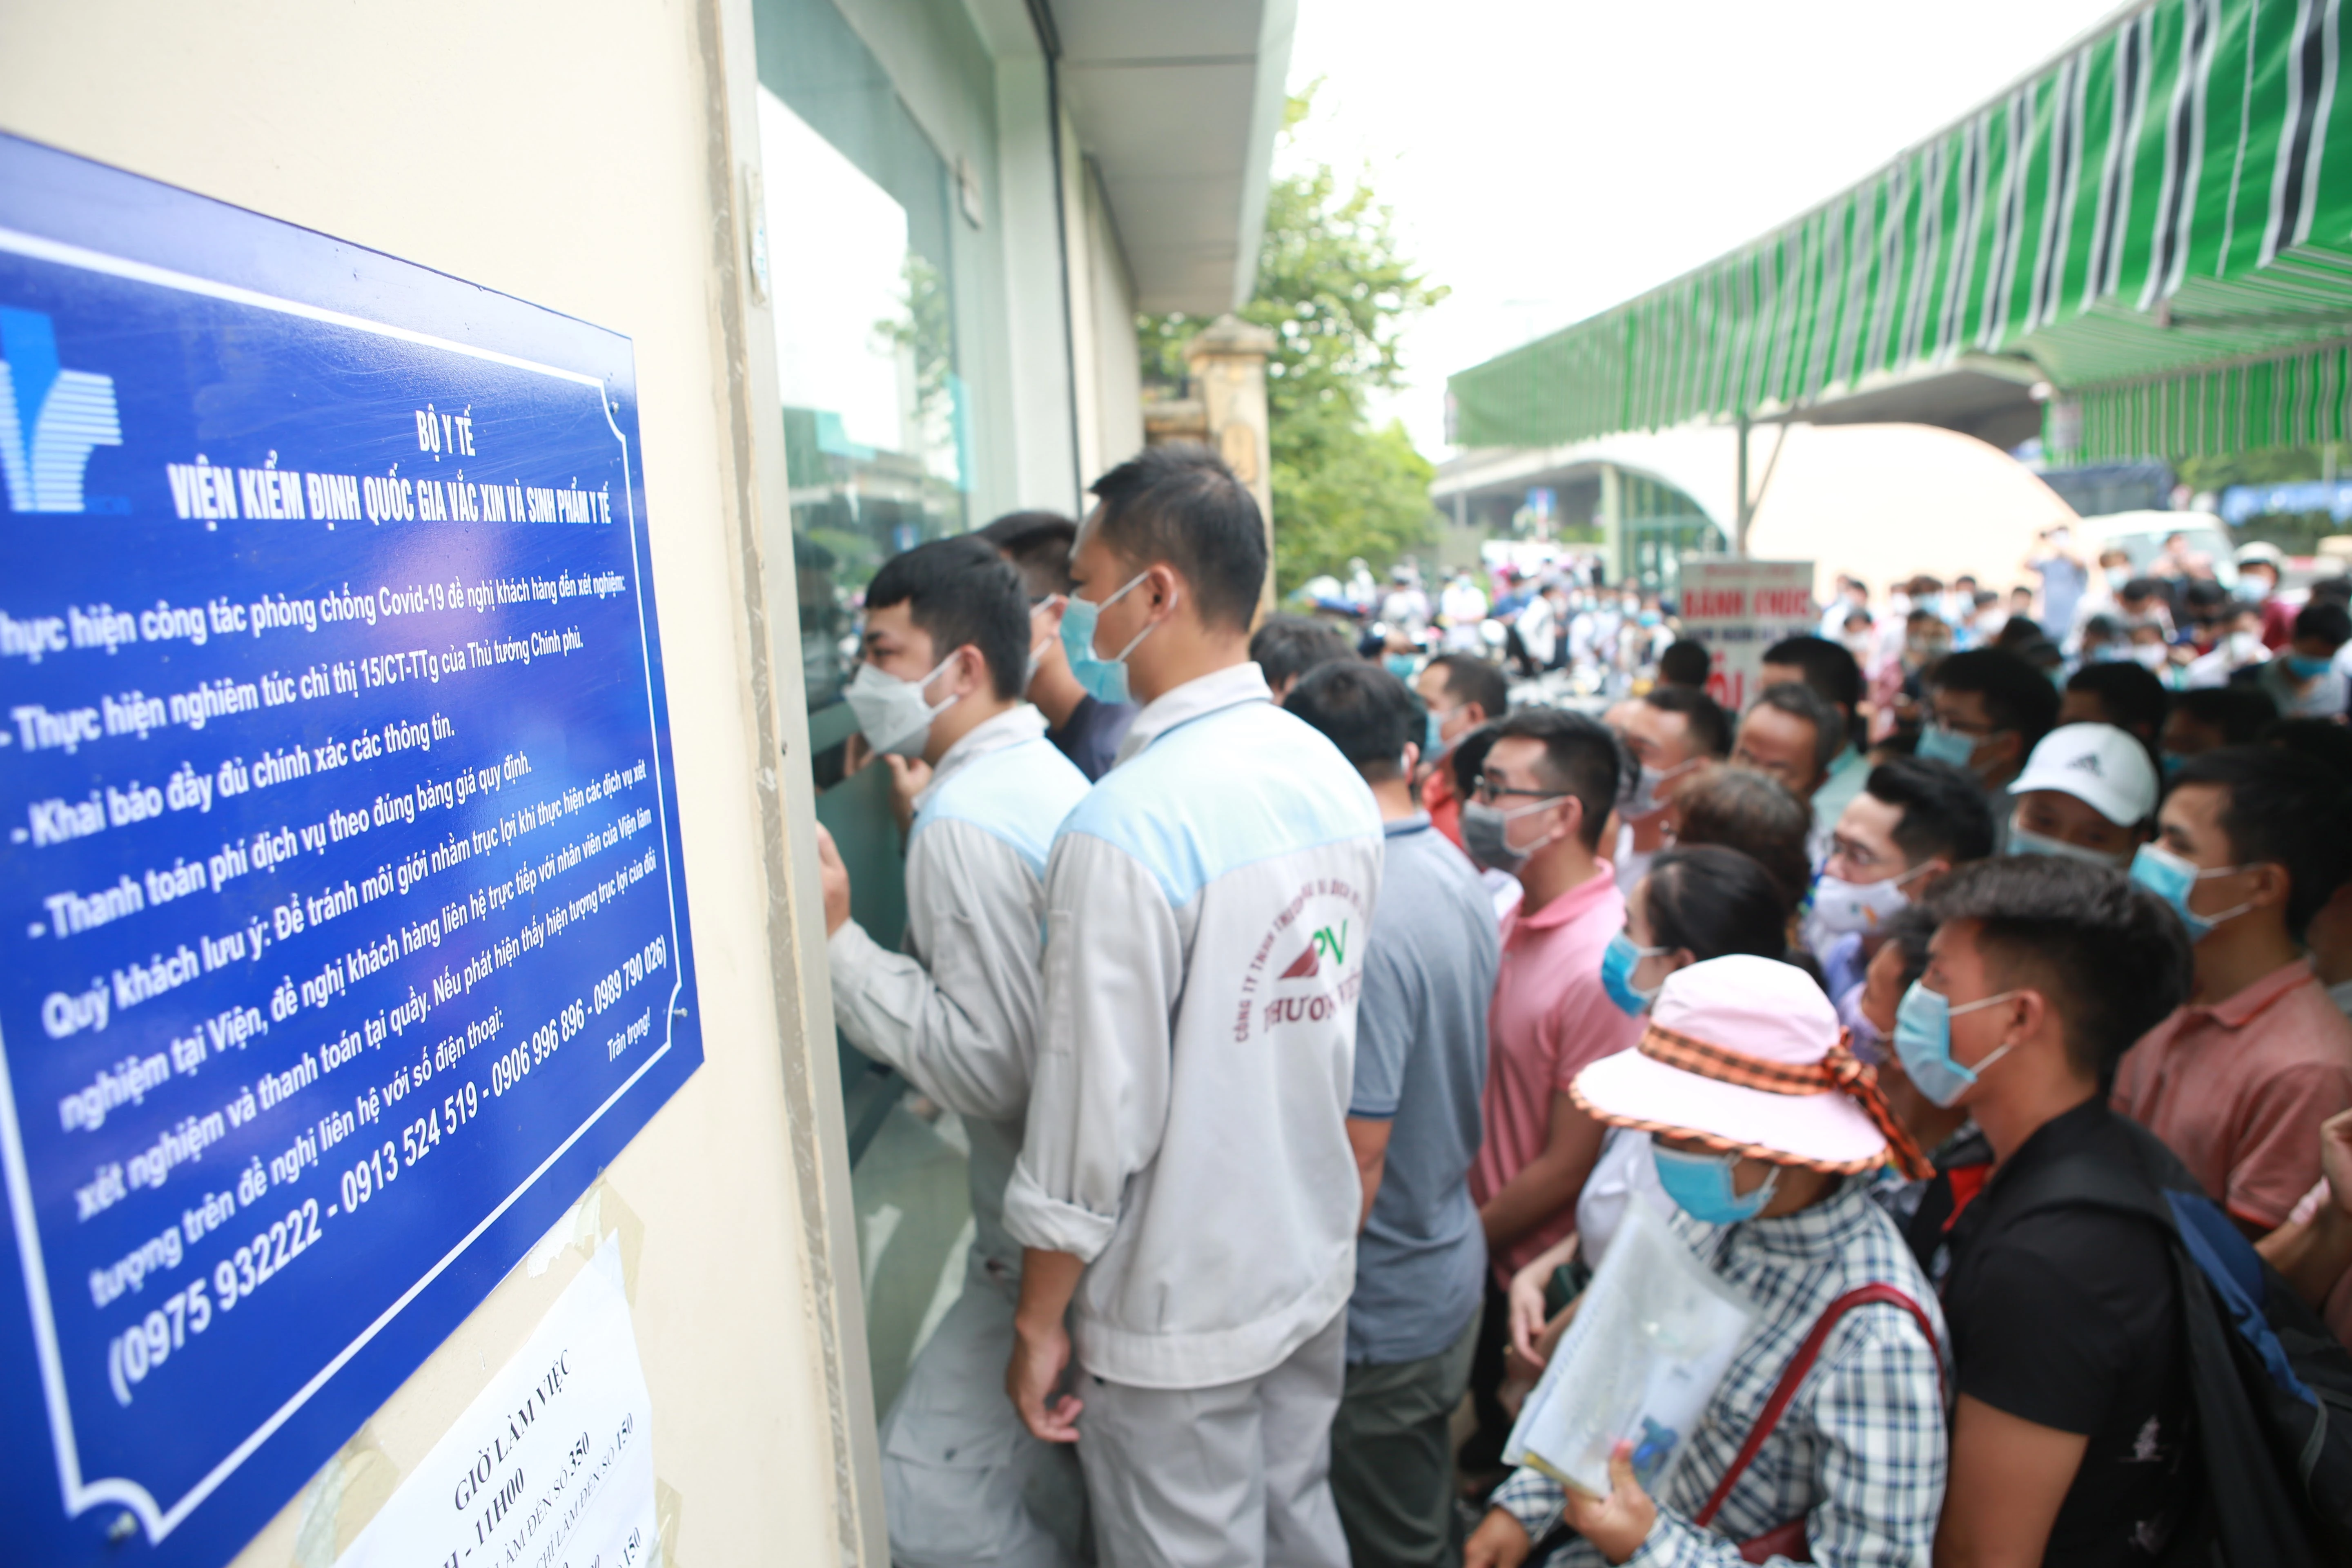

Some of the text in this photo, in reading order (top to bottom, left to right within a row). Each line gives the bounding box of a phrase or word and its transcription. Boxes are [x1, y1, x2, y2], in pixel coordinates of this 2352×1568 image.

[166, 449, 611, 532] VIỆN KIỂM ĐỊNH QUỐC GIA VẮC XIN VÀ SINH PHẨM Y TẾ
[416, 403, 476, 462] BỘ Y TẾ
[68, 569, 626, 655] hiện công tác phòng chống Covid-19 đề nghị khách hàng đến xét nghiệm:
[9, 625, 584, 755] Thực hiện nghiêm túc chỉ thị 15/CT-TTg của Thủ tướng Chính phủ.
[28, 712, 455, 849] Khai báo đầy đủ chính xác các thông tin.
[42, 751, 532, 940] Thanh toán phí dịch vụ theo đúng bảng giá quy định.
[42, 759, 646, 1040] Quý khách lưu ý: Để tránh môi giới nhằm trục lợi khi thực hiện các dịch vụ xét
[58, 807, 652, 1132] nghiệm tại Viện, đề nghị khách hàng liên hệ trực tiếp với nhân viên của Viện làm
[126, 859, 644, 1191] nghiệm và thanh toán tại quầy. Nếu phát hiện thấy hiện tượng trục lợi của
[607, 1006, 650, 1062] Trân trọng!
[108, 934, 667, 1409] (0975 932222 0913 524 519 0906 996 896 0989 790 026)
[182, 1192, 236, 1245] trên
[237, 1155, 267, 1207] đề
[270, 1127, 318, 1184] nghị
[318, 1111, 355, 1152] liên
[357, 1086, 380, 1124] hệ
[382, 1066, 410, 1107] với
[412, 1046, 432, 1088] số
[436, 1035, 466, 1072] điện
[468, 1006, 504, 1049] thoại:
[455, 1348, 572, 1510] GIỜ LÀM VIỆC
[526, 1432, 589, 1538] ĐẾN SỐ 350
[556, 1500, 578, 1548] LÀM
[580, 1466, 599, 1509] ĐẾN
[617, 1412, 633, 1451] 150
[474, 1468, 524, 1549] 11H00
[624, 1527, 641, 1566] 150
